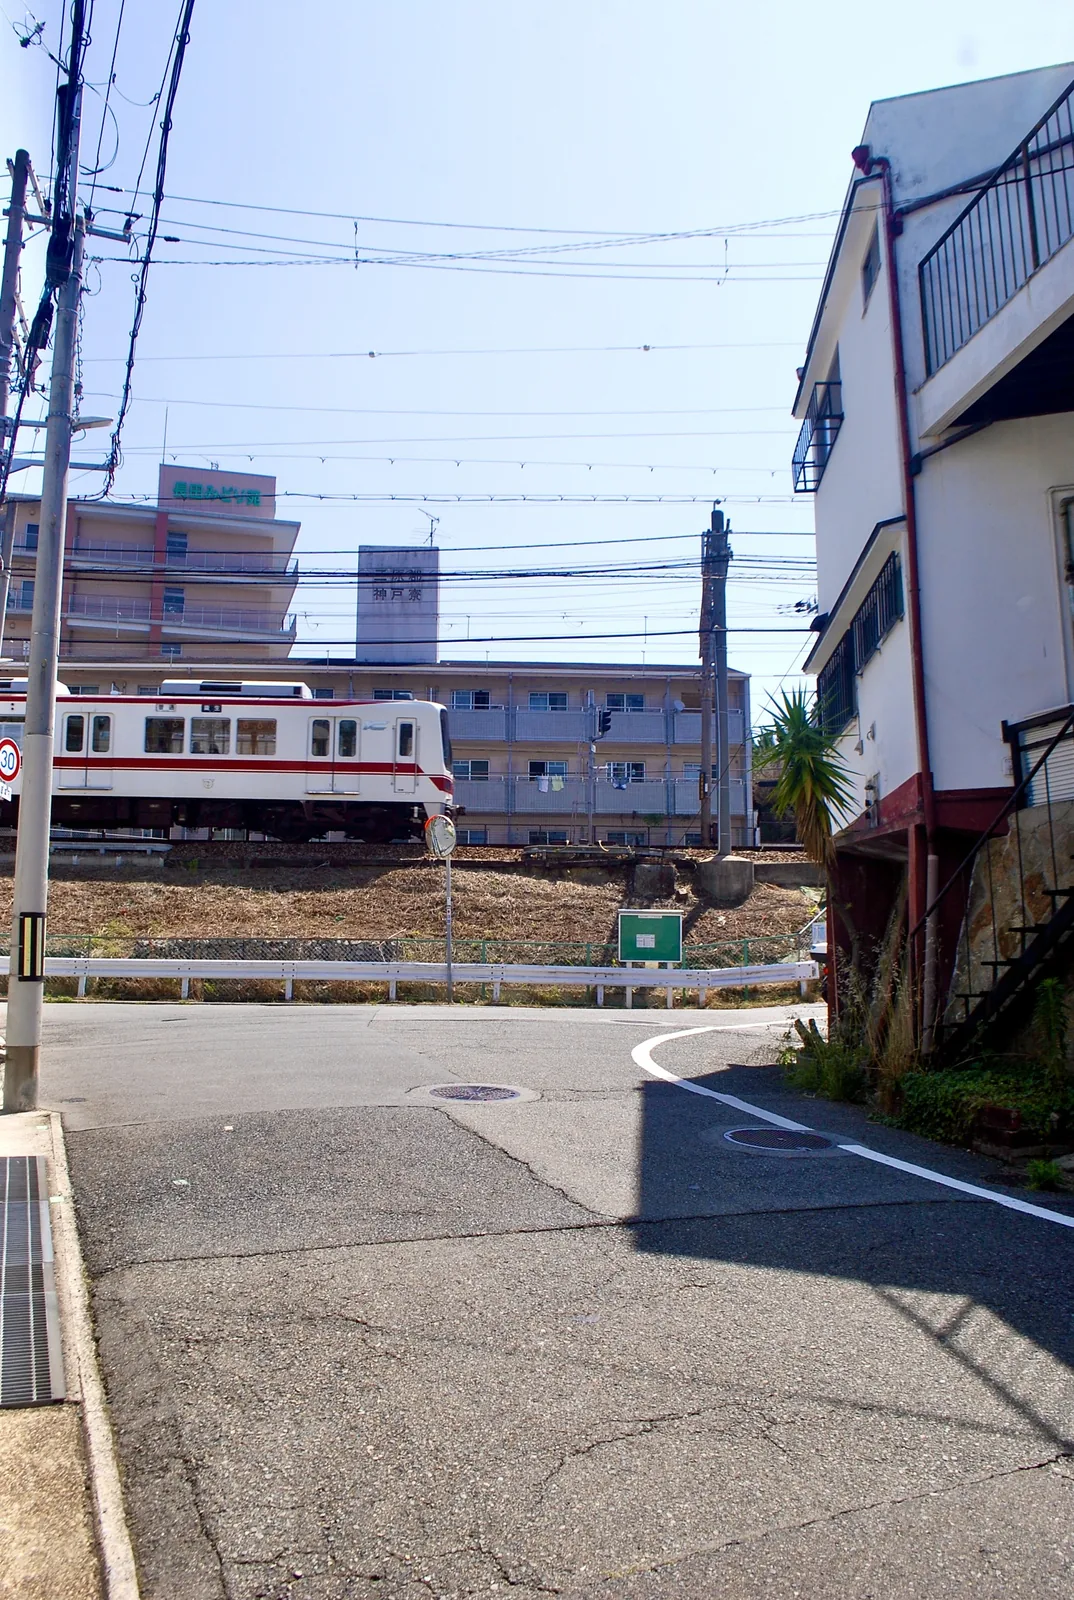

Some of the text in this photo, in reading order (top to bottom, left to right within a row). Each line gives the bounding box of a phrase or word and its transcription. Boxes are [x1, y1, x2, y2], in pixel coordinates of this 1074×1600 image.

[373, 587, 422, 602] 神戸寮
[0, 750, 15, 770] 30
